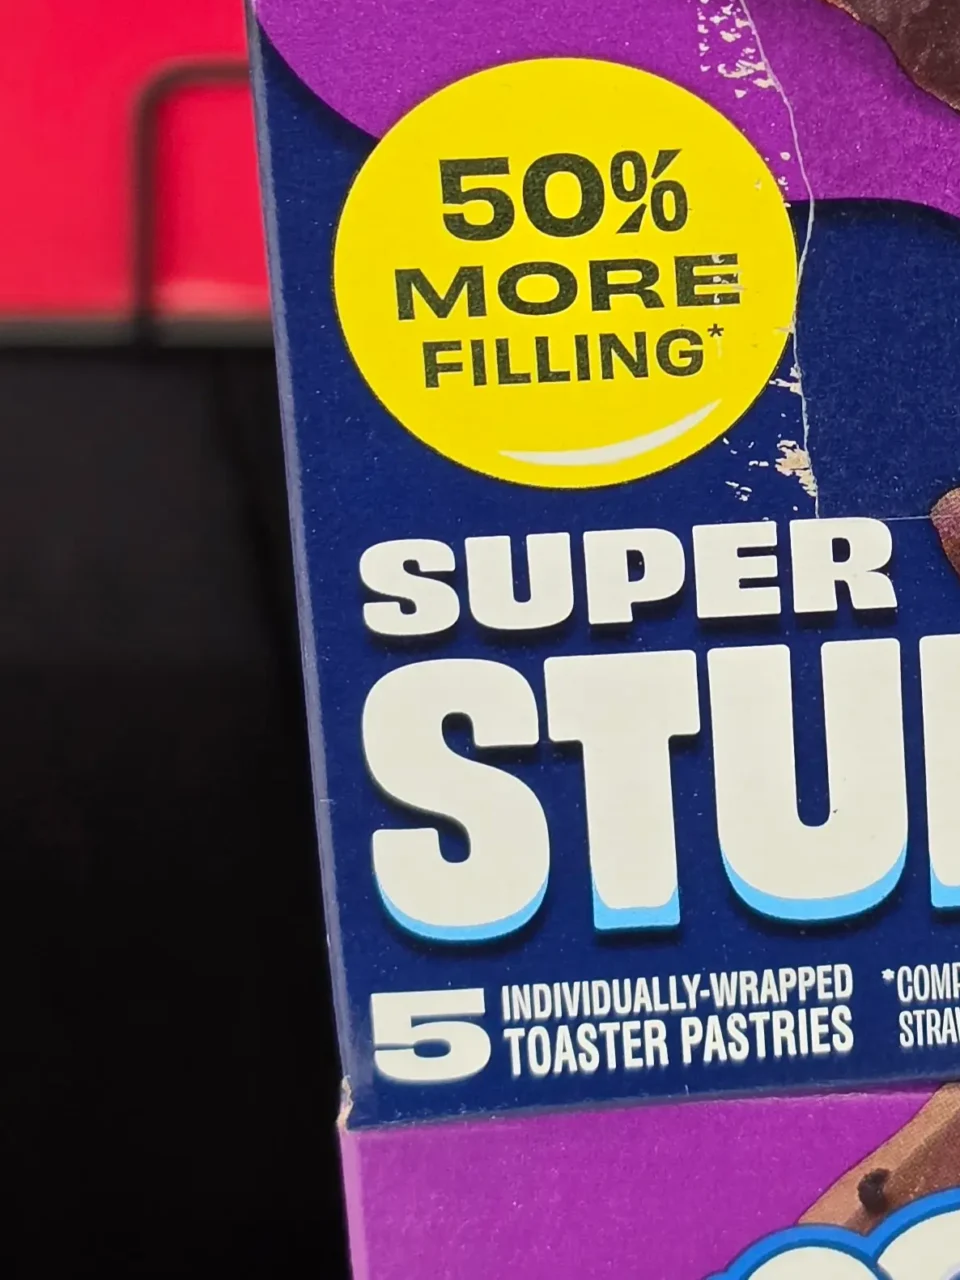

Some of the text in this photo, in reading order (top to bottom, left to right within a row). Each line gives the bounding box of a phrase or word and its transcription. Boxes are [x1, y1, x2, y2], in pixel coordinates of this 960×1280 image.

[438, 148, 689, 242] 50%
[394, 252, 741, 321] MORE
[358, 515, 898, 637] SUPER
[501, 963, 854, 1021] INDIVIDUALLY-WRAPPED
[371, 987, 492, 1082] 5
[503, 1004, 855, 1076] TOASTER PASTRIES
